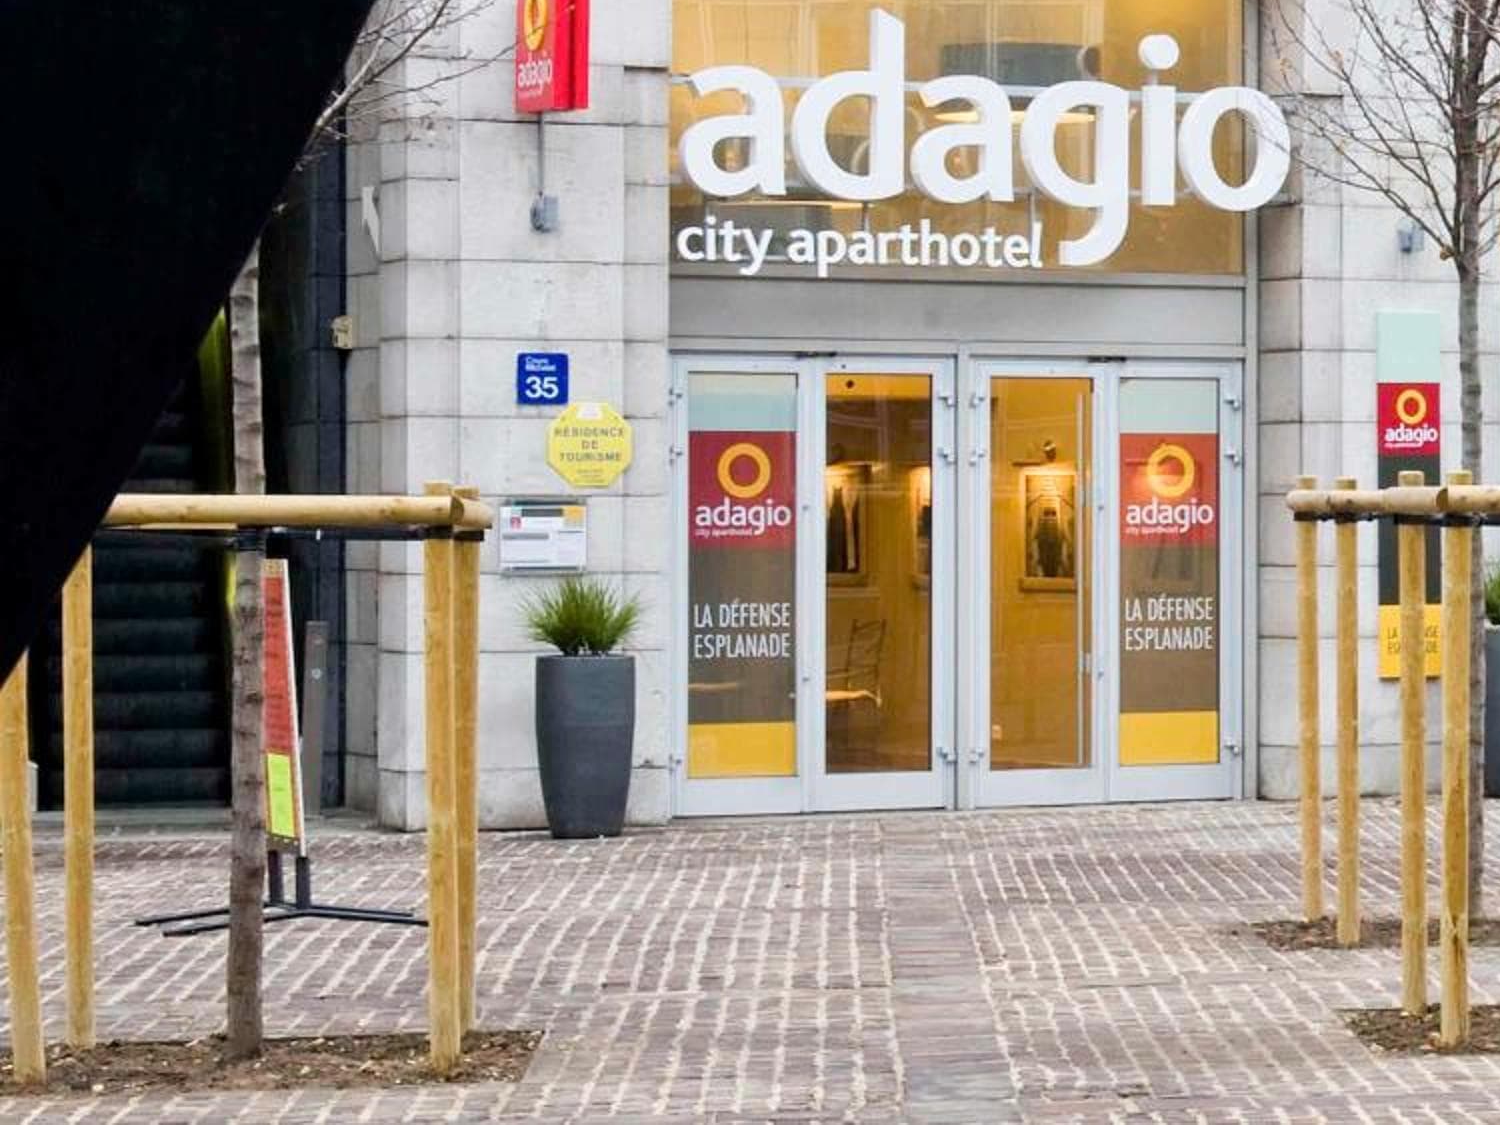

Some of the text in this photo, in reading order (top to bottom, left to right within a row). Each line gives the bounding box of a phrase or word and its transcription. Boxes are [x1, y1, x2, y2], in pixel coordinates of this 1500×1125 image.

[517, 51, 553, 93] adagio
[679, 7, 1292, 266] adagio
[677, 215, 1043, 278] city aparthotel
[525, 376, 559, 398] 35
[1384, 423, 1439, 448] adagio
[695, 496, 792, 535] adagio
[1126, 496, 1214, 534] adagio
[694, 597, 791, 627] LA DÉFENSE
[1125, 592, 1214, 621] LA DÉFENSE
[694, 633, 791, 658] ESPLANADE
[1125, 626, 1213, 650] ESPLANADE
